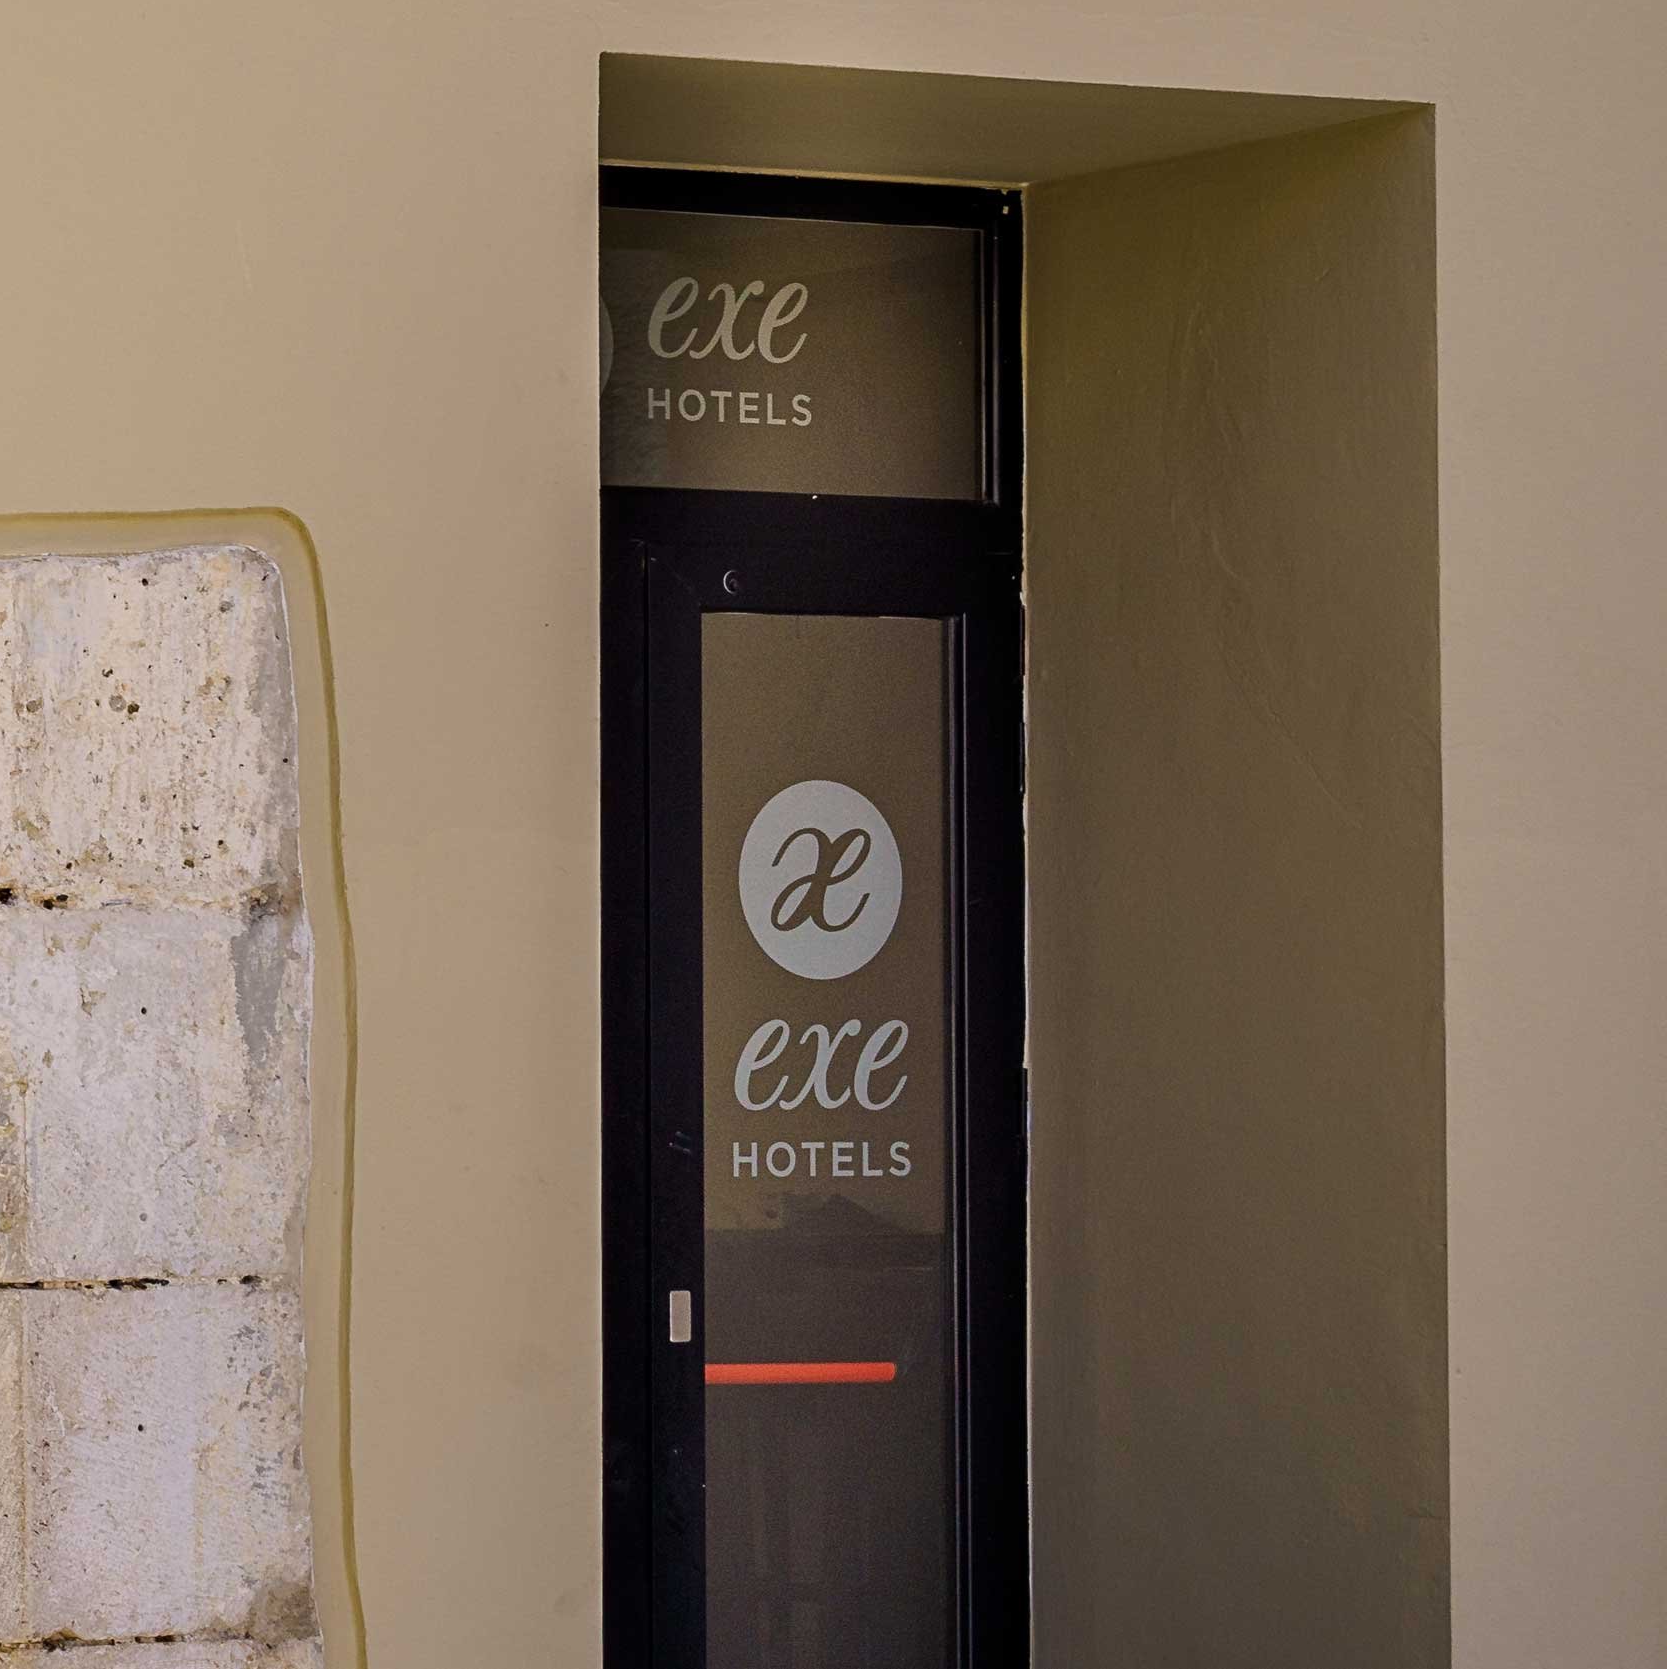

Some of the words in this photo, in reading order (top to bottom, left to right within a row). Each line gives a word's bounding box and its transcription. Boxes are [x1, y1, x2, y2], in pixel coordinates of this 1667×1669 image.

[646, 275, 810, 365] exe
[646, 387, 813, 427] HOTELS
[733, 1018, 910, 1112] exe
[732, 1140, 913, 1178] HOTELS
